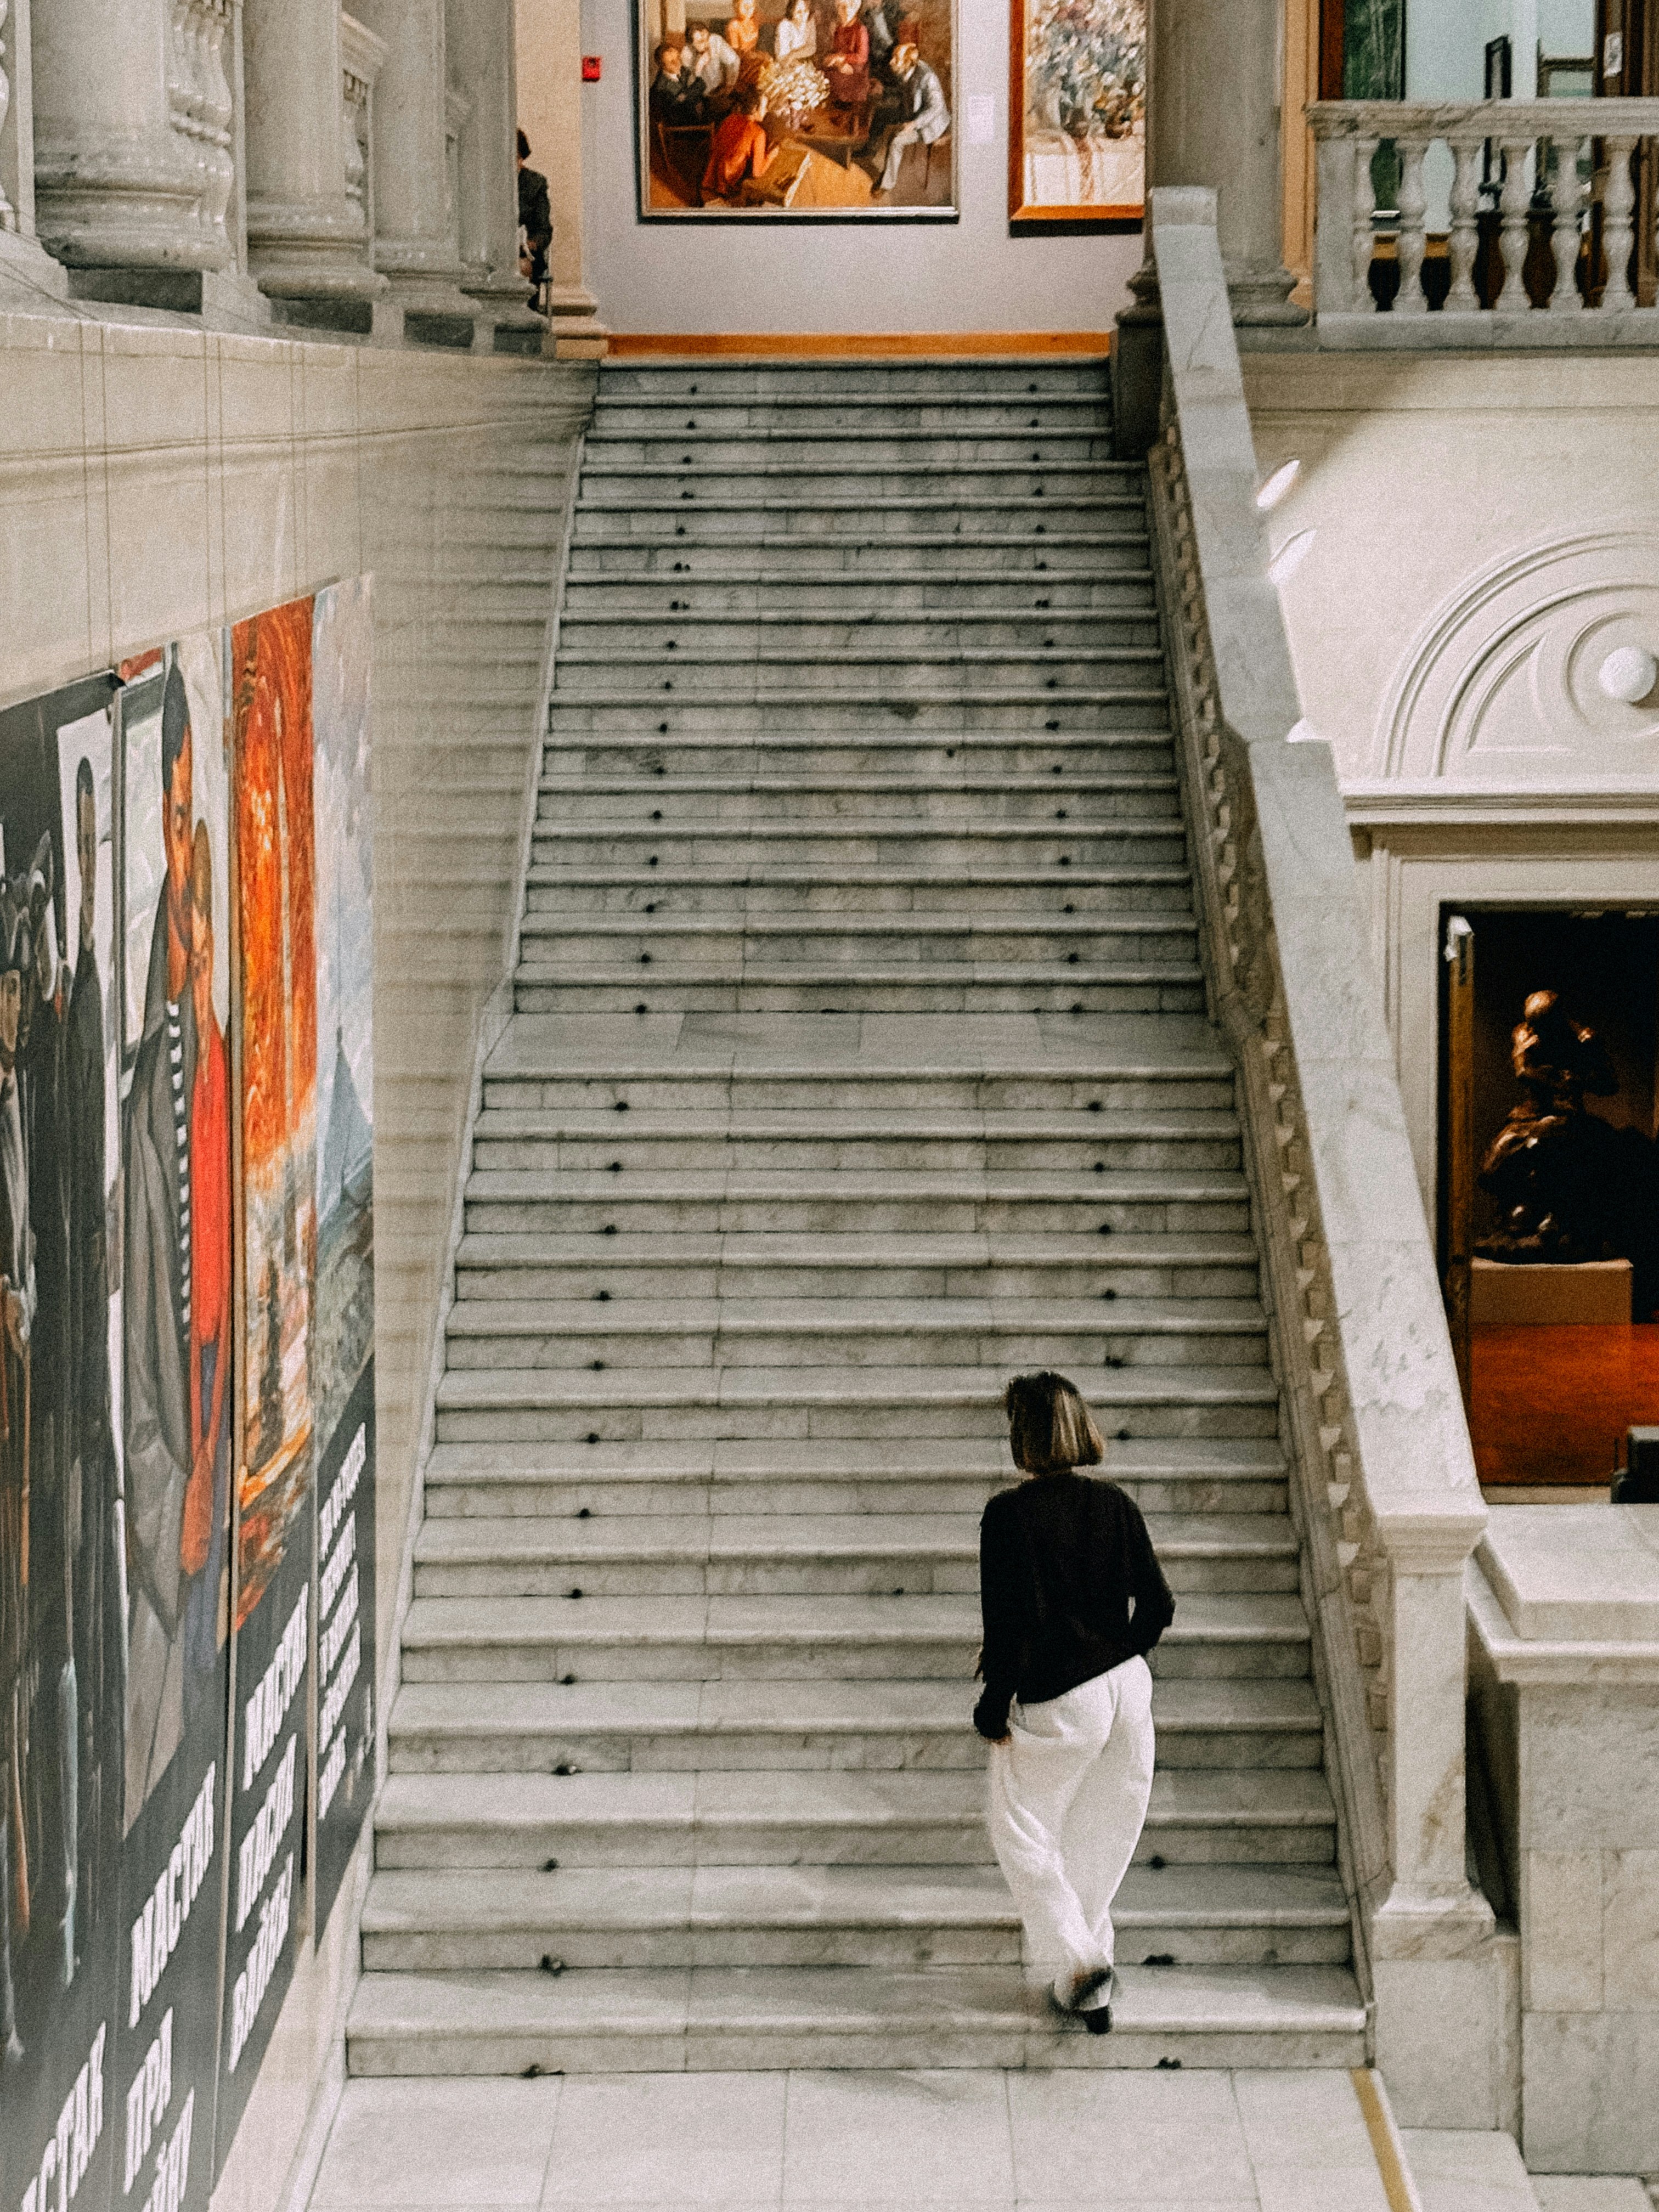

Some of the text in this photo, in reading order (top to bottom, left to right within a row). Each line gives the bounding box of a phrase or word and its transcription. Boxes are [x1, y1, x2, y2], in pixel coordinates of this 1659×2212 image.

[242, 1582, 309, 1791] МАСТАК
[128, 1760, 216, 2028] МАСТАК
[122, 2007, 173, 2196] ПРА
[140, 2086, 195, 2212] ЙНУ
